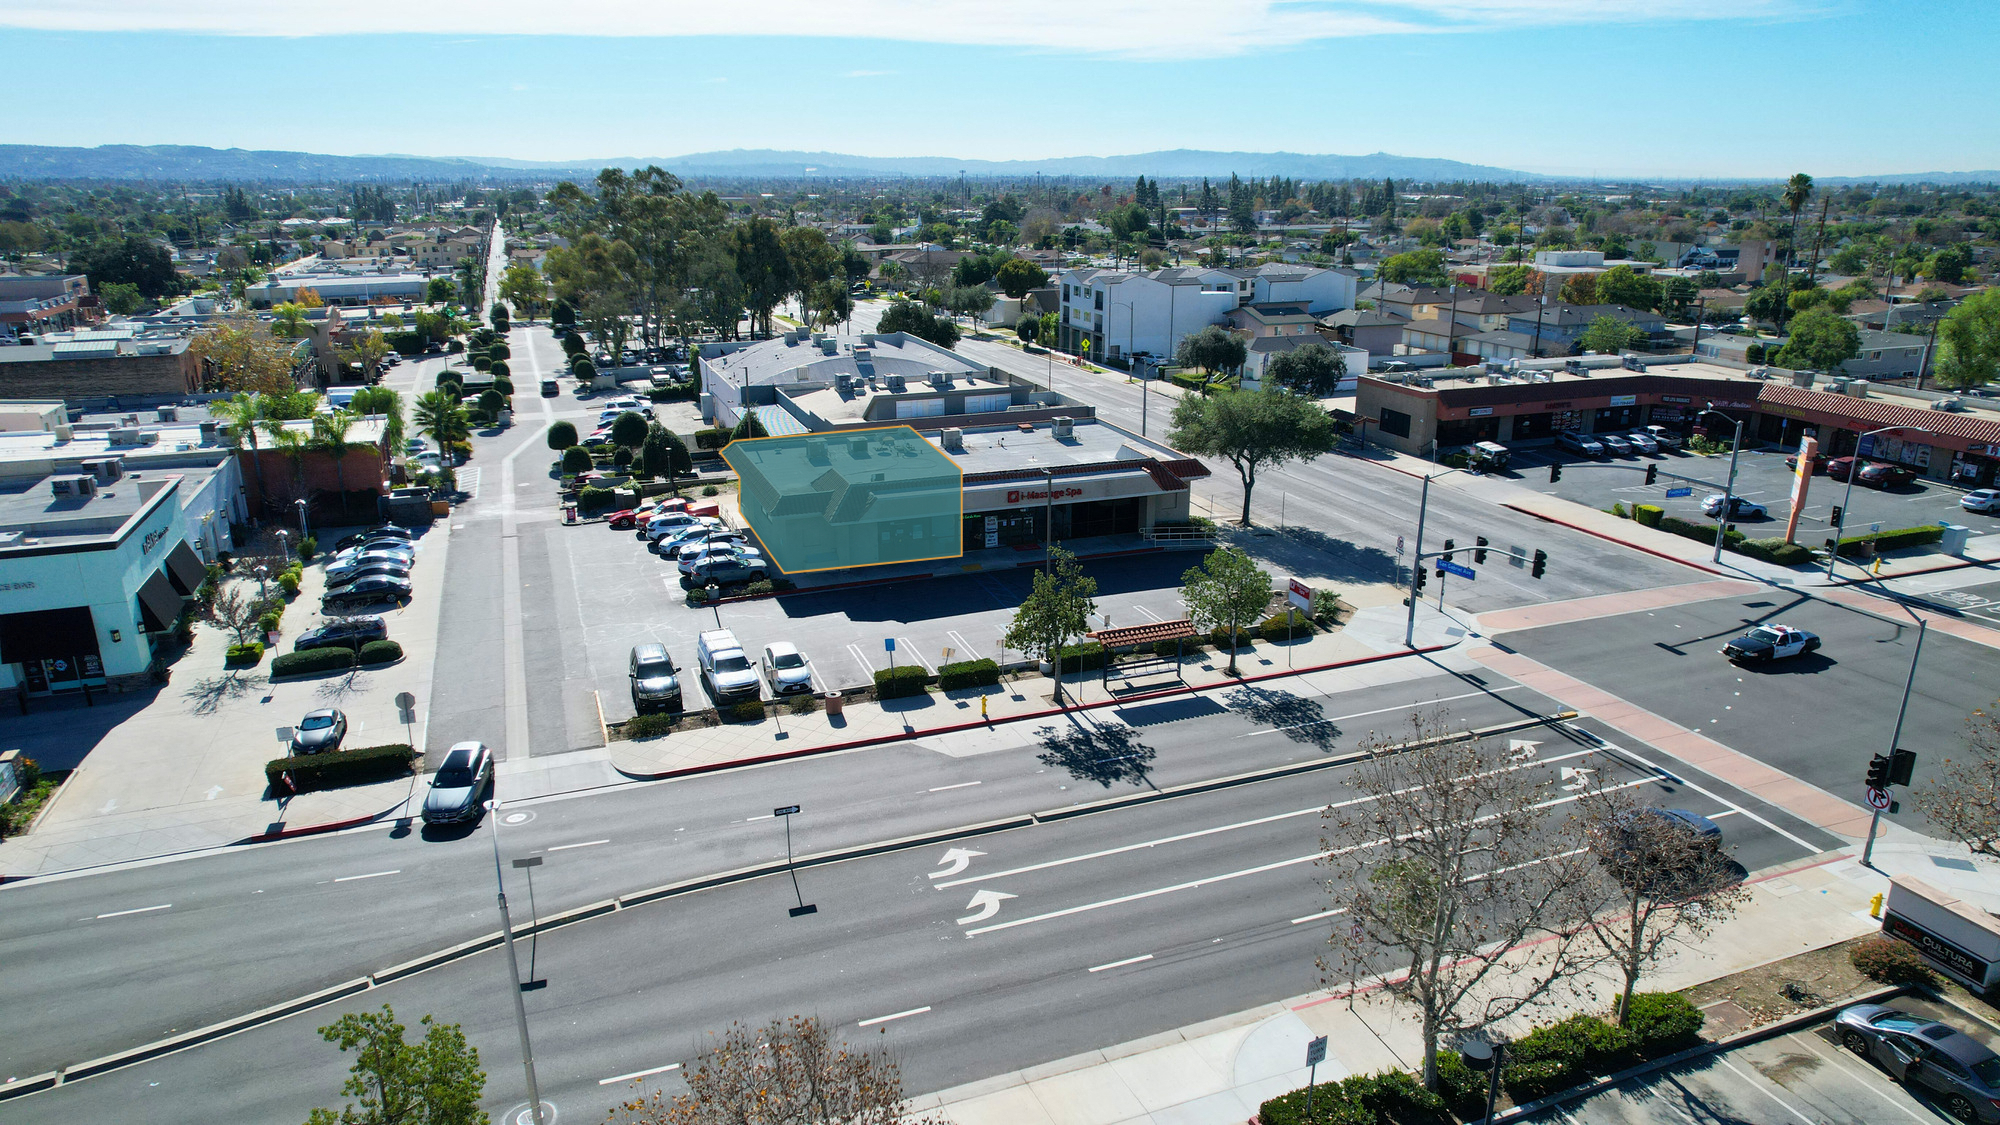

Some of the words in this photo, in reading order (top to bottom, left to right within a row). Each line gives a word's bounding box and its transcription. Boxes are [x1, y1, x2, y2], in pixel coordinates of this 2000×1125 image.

[1065, 487, 1082, 498] Spa
[1894, 921, 1922, 940] CAFE
[1922, 935, 1973, 970] CULTURA
[1927, 948, 1947, 961] LUNCH
[1950, 959, 1973, 975] COFFEE
[1310, 1038, 1325, 1048] RIGHT
[1310, 1046, 1324, 1056] TURN
[1309, 1053, 1324, 1063] ONLY
